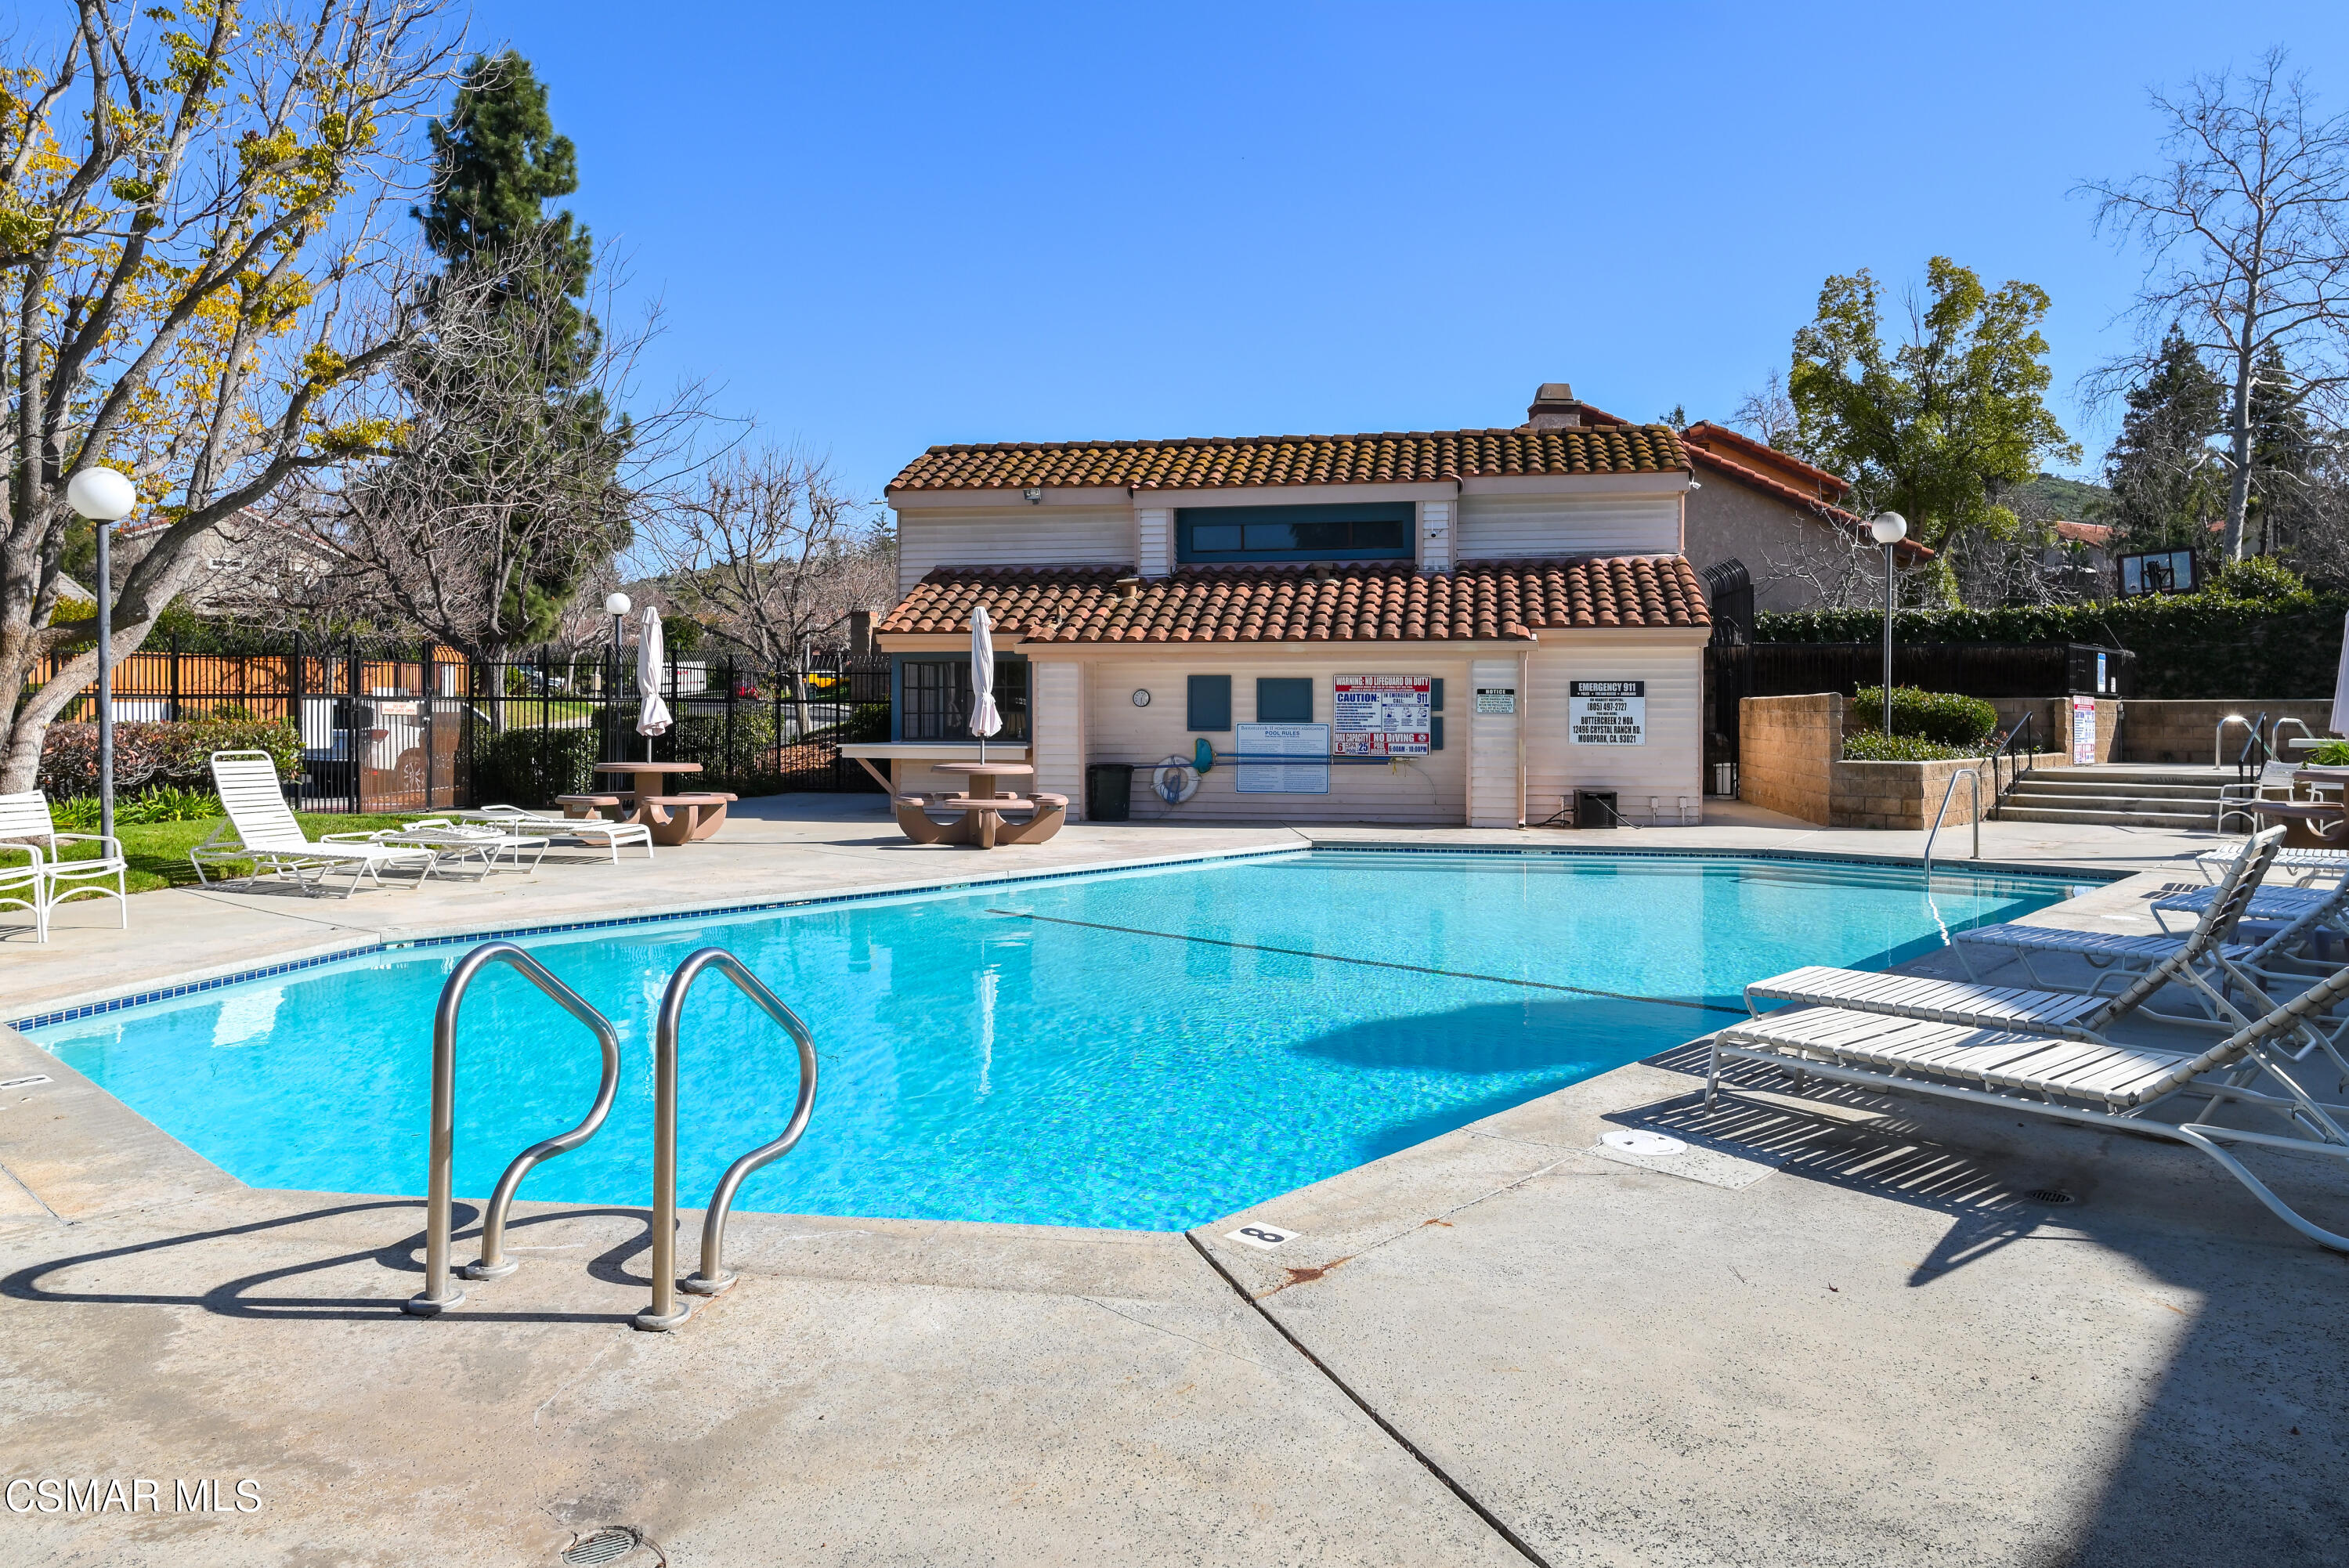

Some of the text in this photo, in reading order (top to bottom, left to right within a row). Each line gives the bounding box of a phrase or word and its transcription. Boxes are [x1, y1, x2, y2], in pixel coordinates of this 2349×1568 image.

[1336, 677, 1428, 686] WARNING: NO LIFEGUARD ON DUTY
[1579, 683, 1636, 691] EMERGENCY 911
[1337, 693, 1379, 702] CAUTION:
[1417, 693, 1427, 703] 911
[1587, 703, 1627, 711] (805) 497-2727
[1581, 716, 1633, 725] BUTTERCREEK 2 HOA
[1573, 726, 1641, 734] 12496 CRYSTAL RANCH RD.
[1346, 733, 1369, 742] CAPACITY
[1374, 733, 1414, 742] NO DIVING
[1578, 735, 1608, 744] MOORPARK,
[1620, 735, 1636, 743] 93021
[1359, 743, 1368, 751] 25
[1240, 1228, 1285, 1242] 8
